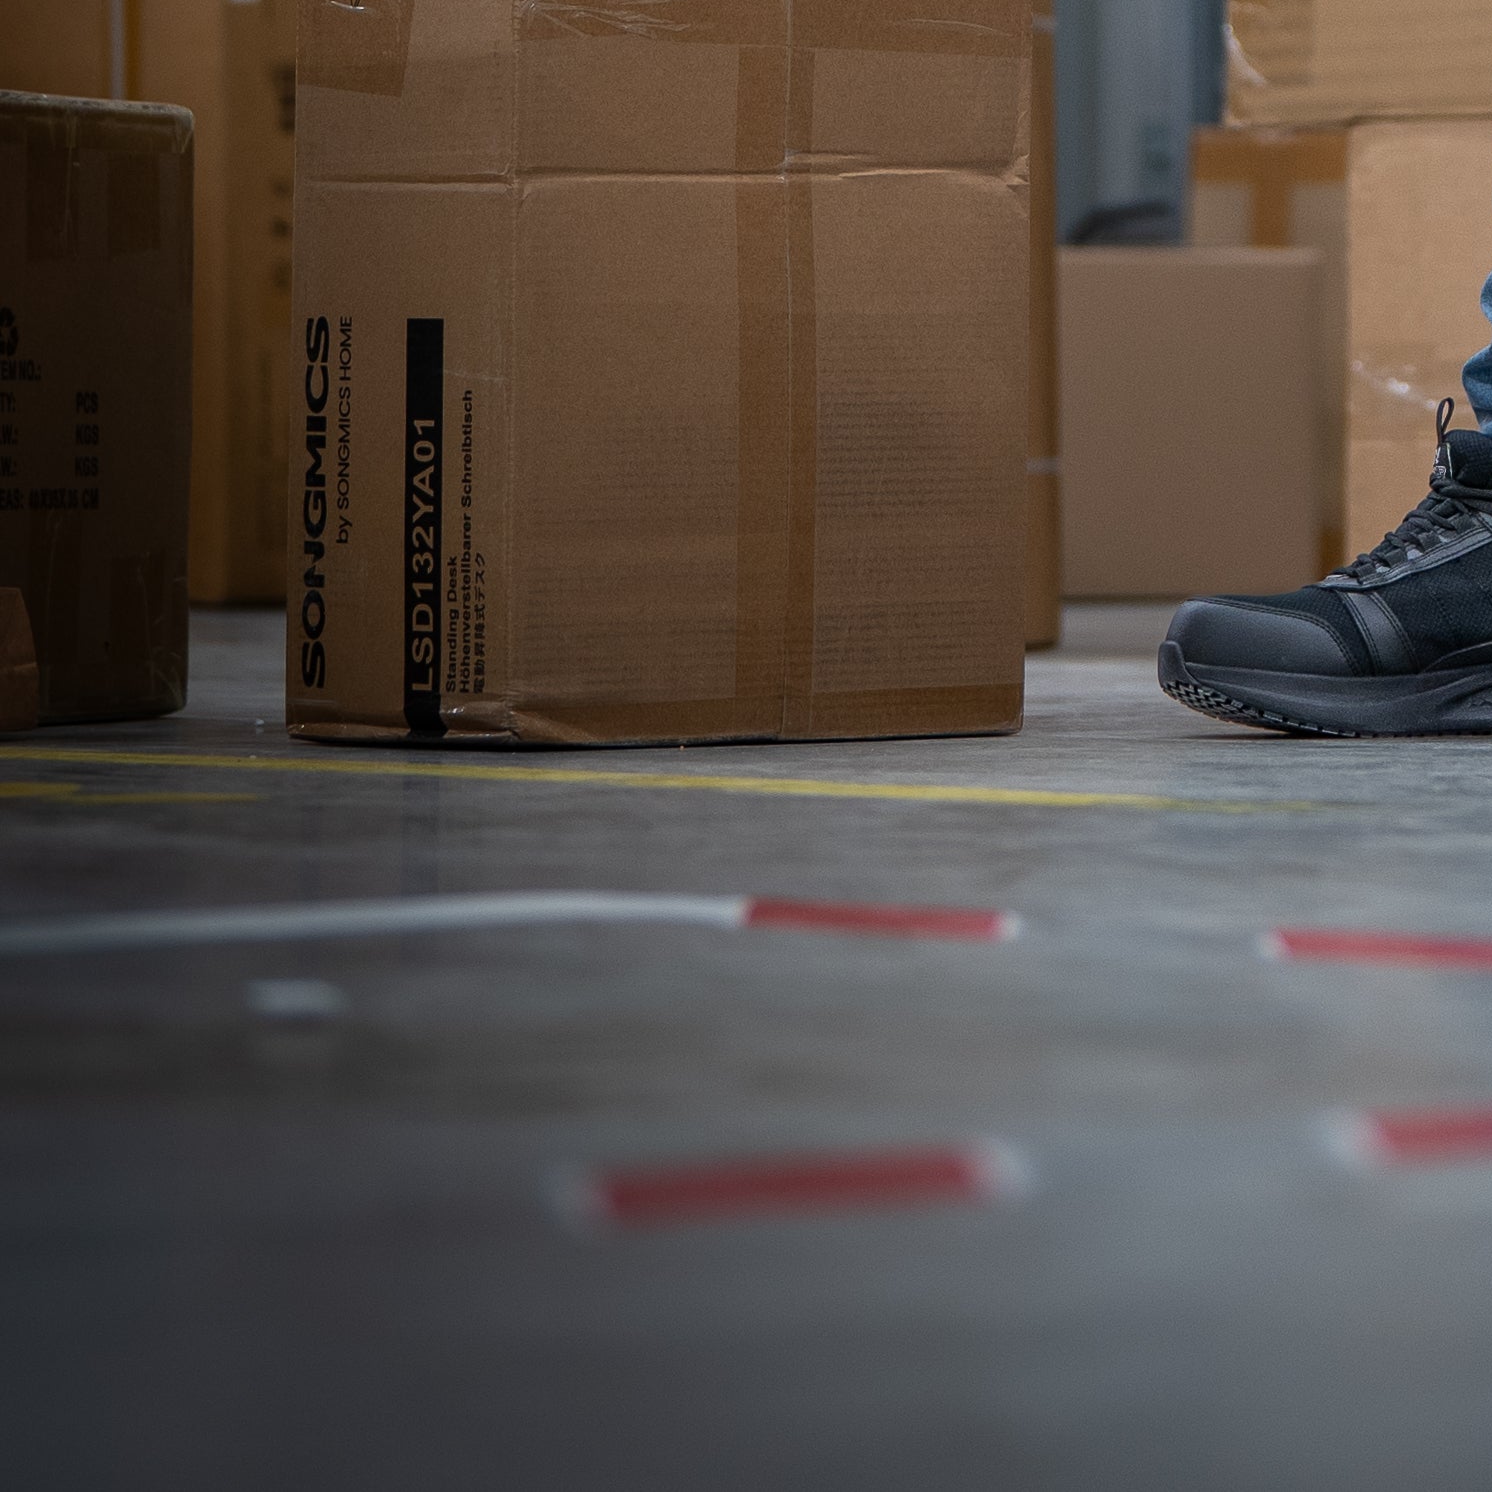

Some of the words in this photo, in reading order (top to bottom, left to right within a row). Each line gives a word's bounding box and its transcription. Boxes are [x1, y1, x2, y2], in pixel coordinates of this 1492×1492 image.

[339, 316, 352, 382] HOME
[75, 391, 99, 414] PCS
[75, 424, 99, 445] KGS
[74, 456, 99, 478] KGS
[337, 386, 350, 509] SONGMICS
[460, 389, 473, 508] Schreibtisch
[81, 487, 99, 510] CM
[302, 316, 330, 689] SONGMICS
[336, 515, 352, 544] by
[411, 418, 435, 692] LSD132YA01
[446, 556, 458, 603] Desk
[459, 513, 472, 693] Höhenverstellbarer
[446, 609, 459, 693] Standing
